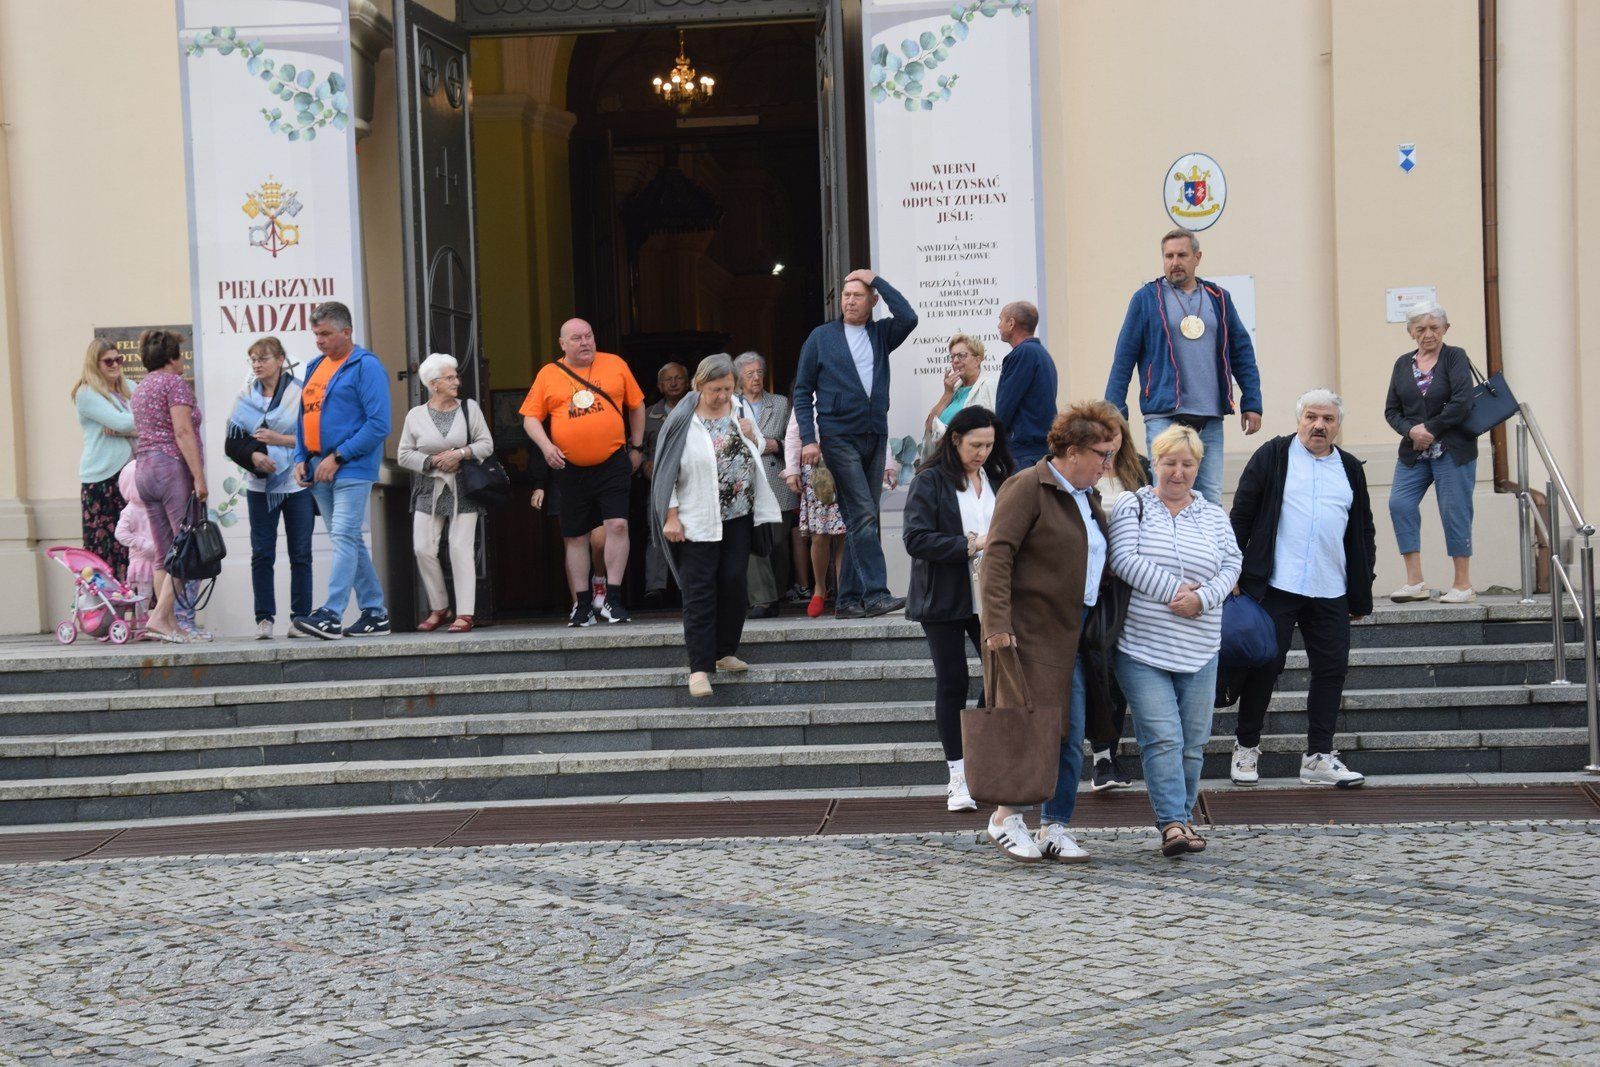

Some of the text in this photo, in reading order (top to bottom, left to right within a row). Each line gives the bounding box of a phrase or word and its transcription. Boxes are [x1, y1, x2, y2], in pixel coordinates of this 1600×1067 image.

[932, 163, 976, 174] WIERNI
[910, 174, 1000, 193] MOGĄ UZYSKAĆ
[902, 196, 950, 208] ODPUST
[937, 208, 974, 223] JEŚLI:
[962, 242, 998, 250] MIEJSCE
[924, 252, 990, 262] JUBILEUSZOWE
[218, 277, 334, 300] PIELGRZYMI
[939, 288, 979, 297] ADORACJI
[919, 298, 1000, 308] EUCHARYSTYCZNEJ
[946, 308, 992, 317] MEDYTACJI
